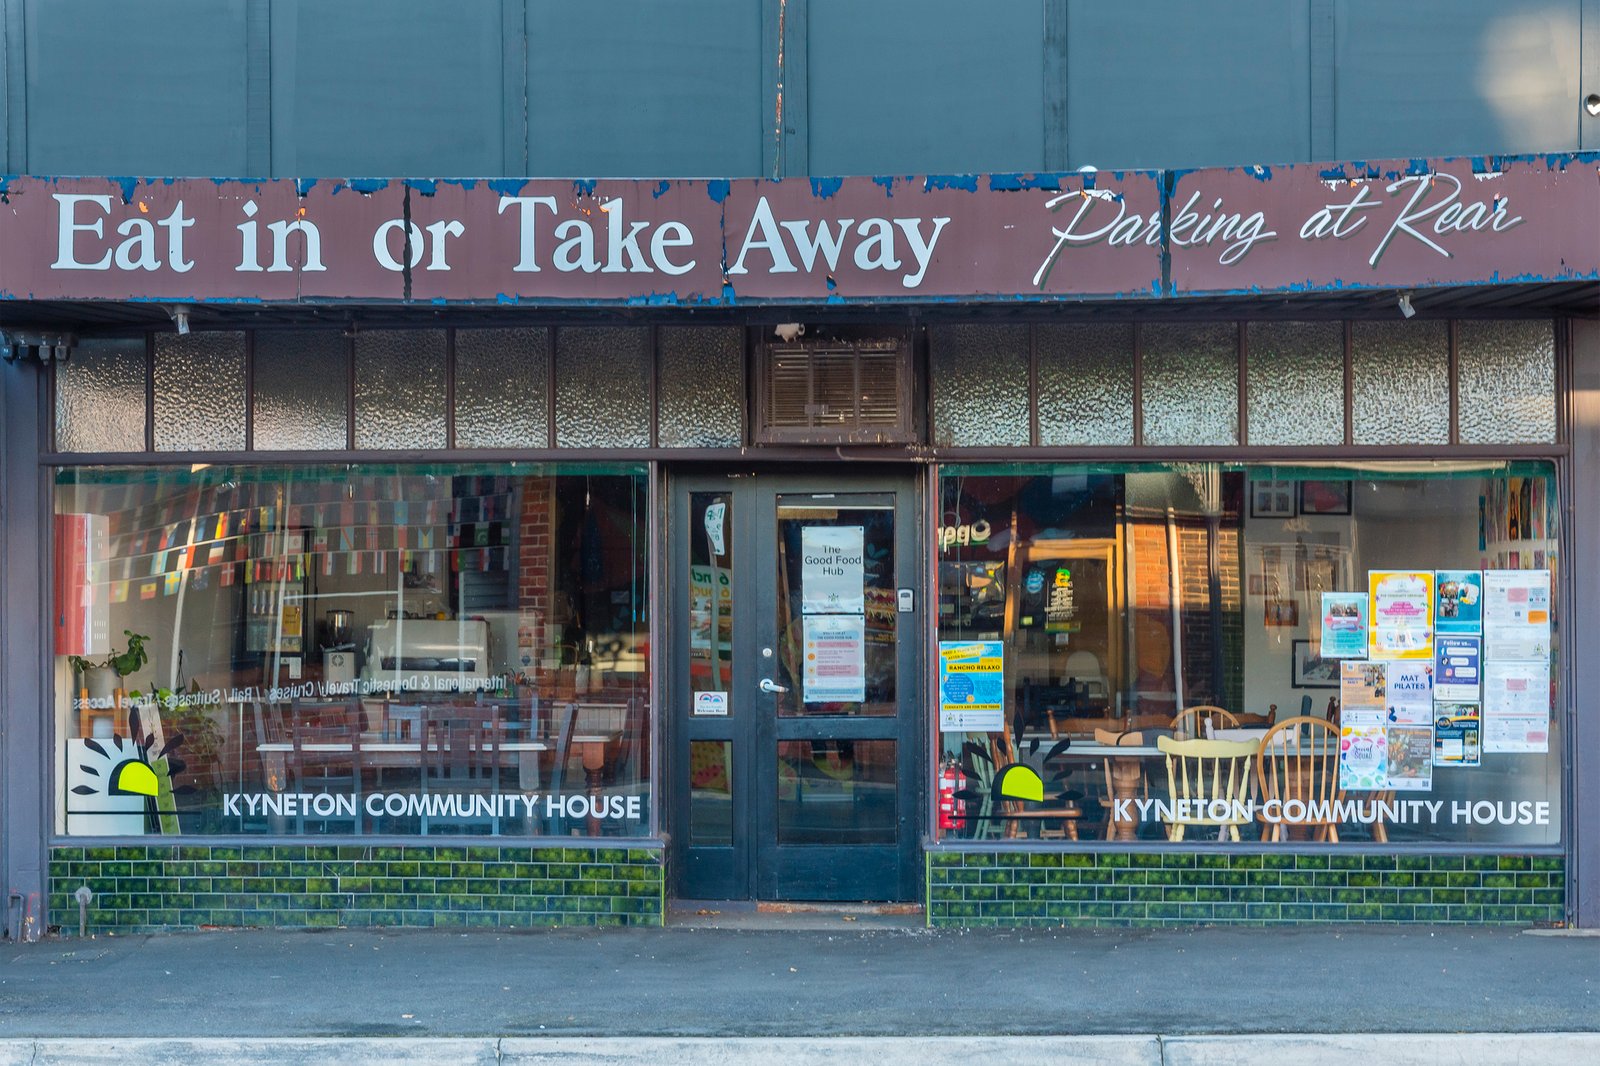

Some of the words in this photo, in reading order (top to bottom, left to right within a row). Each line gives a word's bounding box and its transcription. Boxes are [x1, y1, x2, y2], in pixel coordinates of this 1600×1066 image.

[1032, 189, 1278, 287] Parking
[1299, 185, 1384, 241] at
[1369, 172, 1524, 267] Rear
[50, 193, 196, 273] Eat
[235, 199, 328, 273] in
[372, 218, 466, 272] or
[498, 195, 697, 276] Take
[729, 195, 952, 289] Away
[822, 545, 841, 554] The
[804, 555, 833, 565] Good
[835, 555, 862, 565] Food
[822, 566, 844, 576] Hub
[1400, 674, 1419, 682] MAT
[1394, 682, 1425, 690] PILATES
[222, 792, 357, 817] KYNETON
[365, 792, 539, 818] COMMUNITY
[546, 793, 641, 819] HOUSE
[1113, 798, 1255, 823] KYNETON
[1262, 798, 1444, 824] COMMUNITY
[1451, 800, 1550, 826] HOUSE
